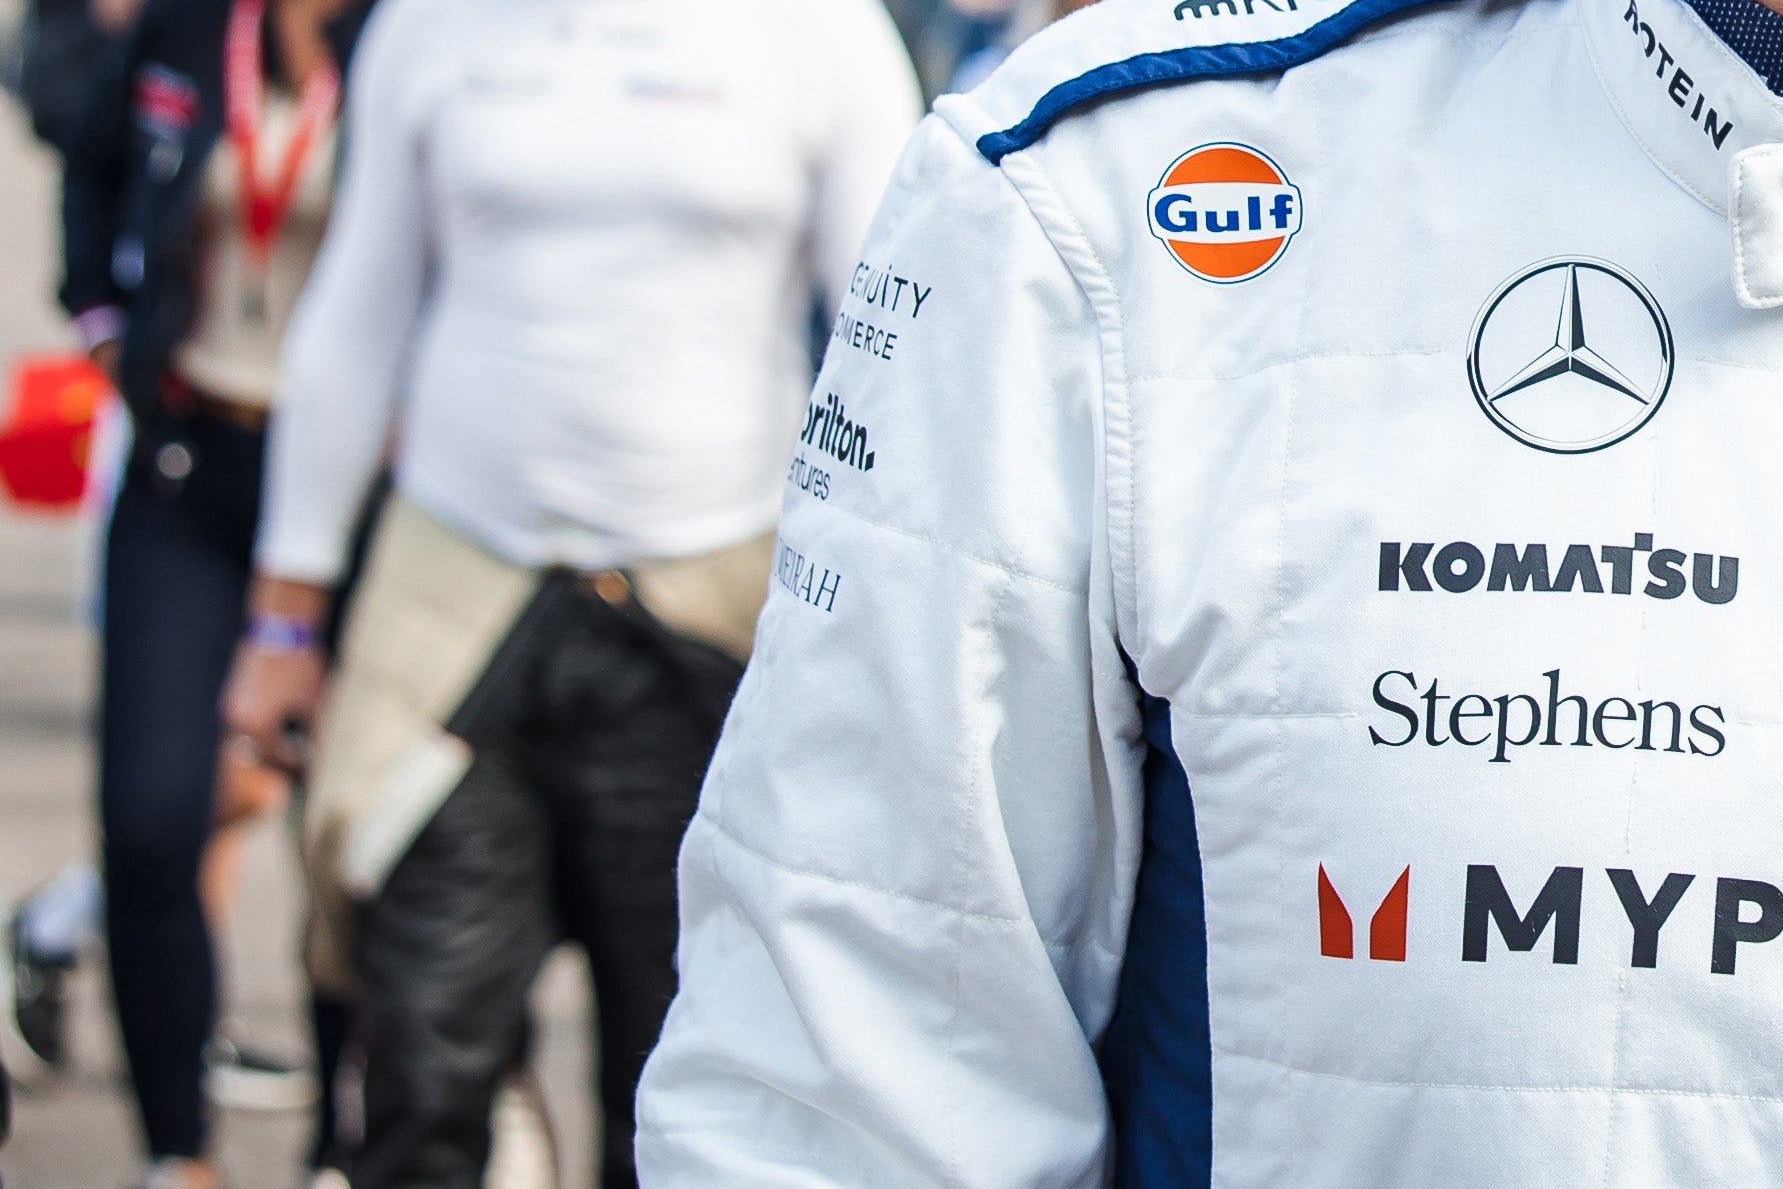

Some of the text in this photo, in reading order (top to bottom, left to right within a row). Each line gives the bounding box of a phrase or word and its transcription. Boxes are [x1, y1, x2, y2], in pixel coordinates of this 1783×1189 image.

[1154, 193, 1294, 234] Gulf
[1378, 532, 1740, 605] KOMATSU
[1368, 668, 1727, 763] Stephens
